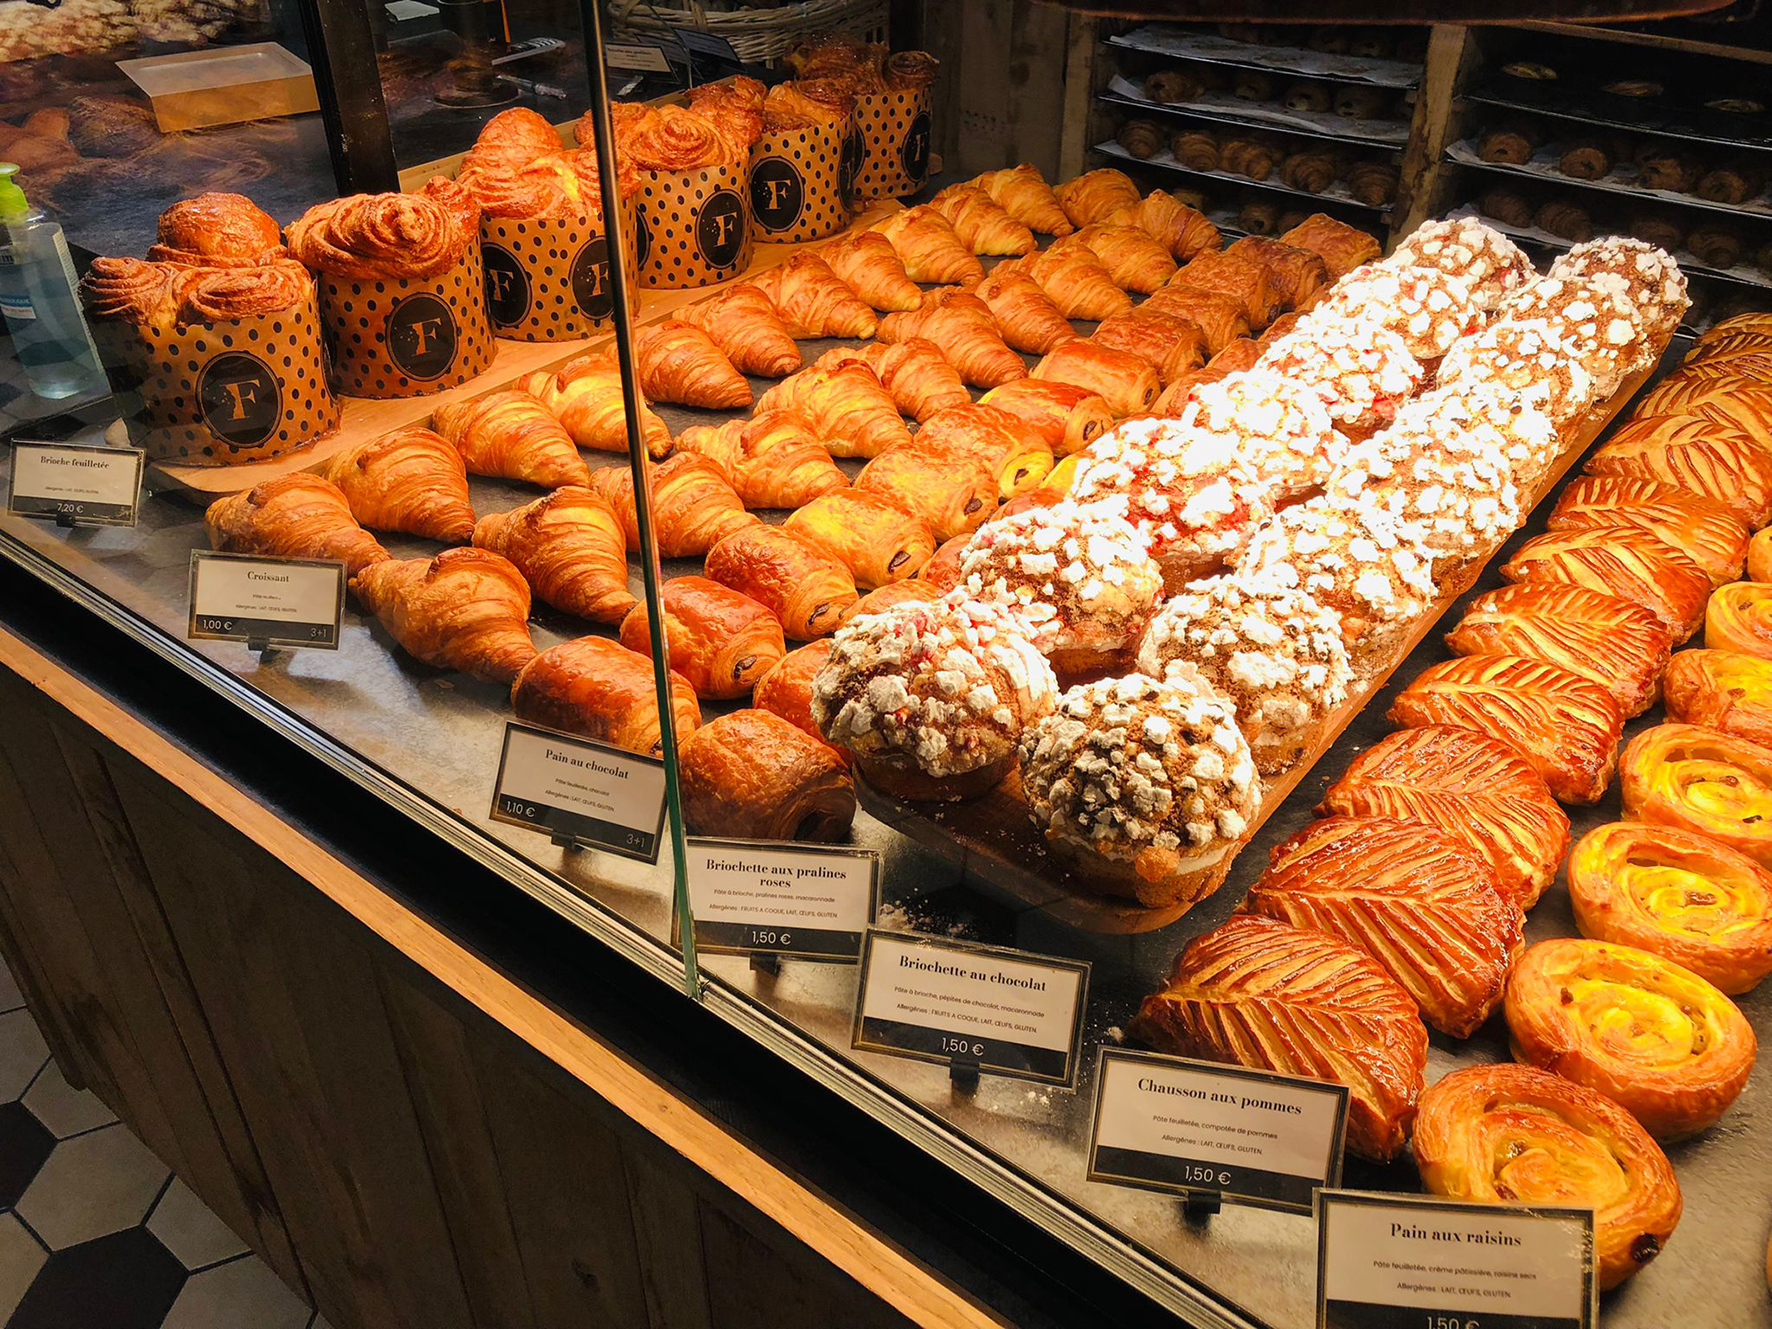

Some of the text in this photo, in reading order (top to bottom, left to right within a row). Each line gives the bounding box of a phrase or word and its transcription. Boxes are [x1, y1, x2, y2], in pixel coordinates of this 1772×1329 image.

[763, 179, 792, 210] F
[712, 211, 738, 248] F
[486, 268, 515, 303] F
[587, 260, 610, 298] F
[407, 317, 442, 357] F
[219, 379, 261, 421] F
[40, 455, 109, 468] Brioche feuilletée
[56, 502, 84, 514] 7,20 €
[246, 570, 289, 583] Croissant
[202, 619, 233, 632] 1,00 €
[310, 627, 326, 638] 3+1
[545, 748, 629, 779] Pain au chocolat
[505, 800, 536, 818] 1,10 €
[625, 833, 645, 848] 3+1
[706, 858, 846, 879] Briochette aux pralines
[760, 878, 791, 888] roses
[752, 930, 791, 945] 1,50 €
[899, 955, 1046, 991] Briochette au chocolat
[914, 990, 938, 999] brioche,
[939, 995, 961, 1003] pépites
[971, 1000, 999, 1010] chocolat,
[1000, 1006, 1045, 1018] macaronnade
[931, 1009, 950, 1017] FRUITS
[956, 1014, 979, 1023] COQUE,
[942, 1037, 984, 1056] 1,50 €
[1138, 1078, 1302, 1114] Chausson aux pommes
[1201, 1123, 1236, 1132] compotée
[1246, 1130, 1278, 1139] pommes
[1185, 1165, 1231, 1185] 1,50 €
[1391, 1222, 1521, 1246] Pain aux raisins
